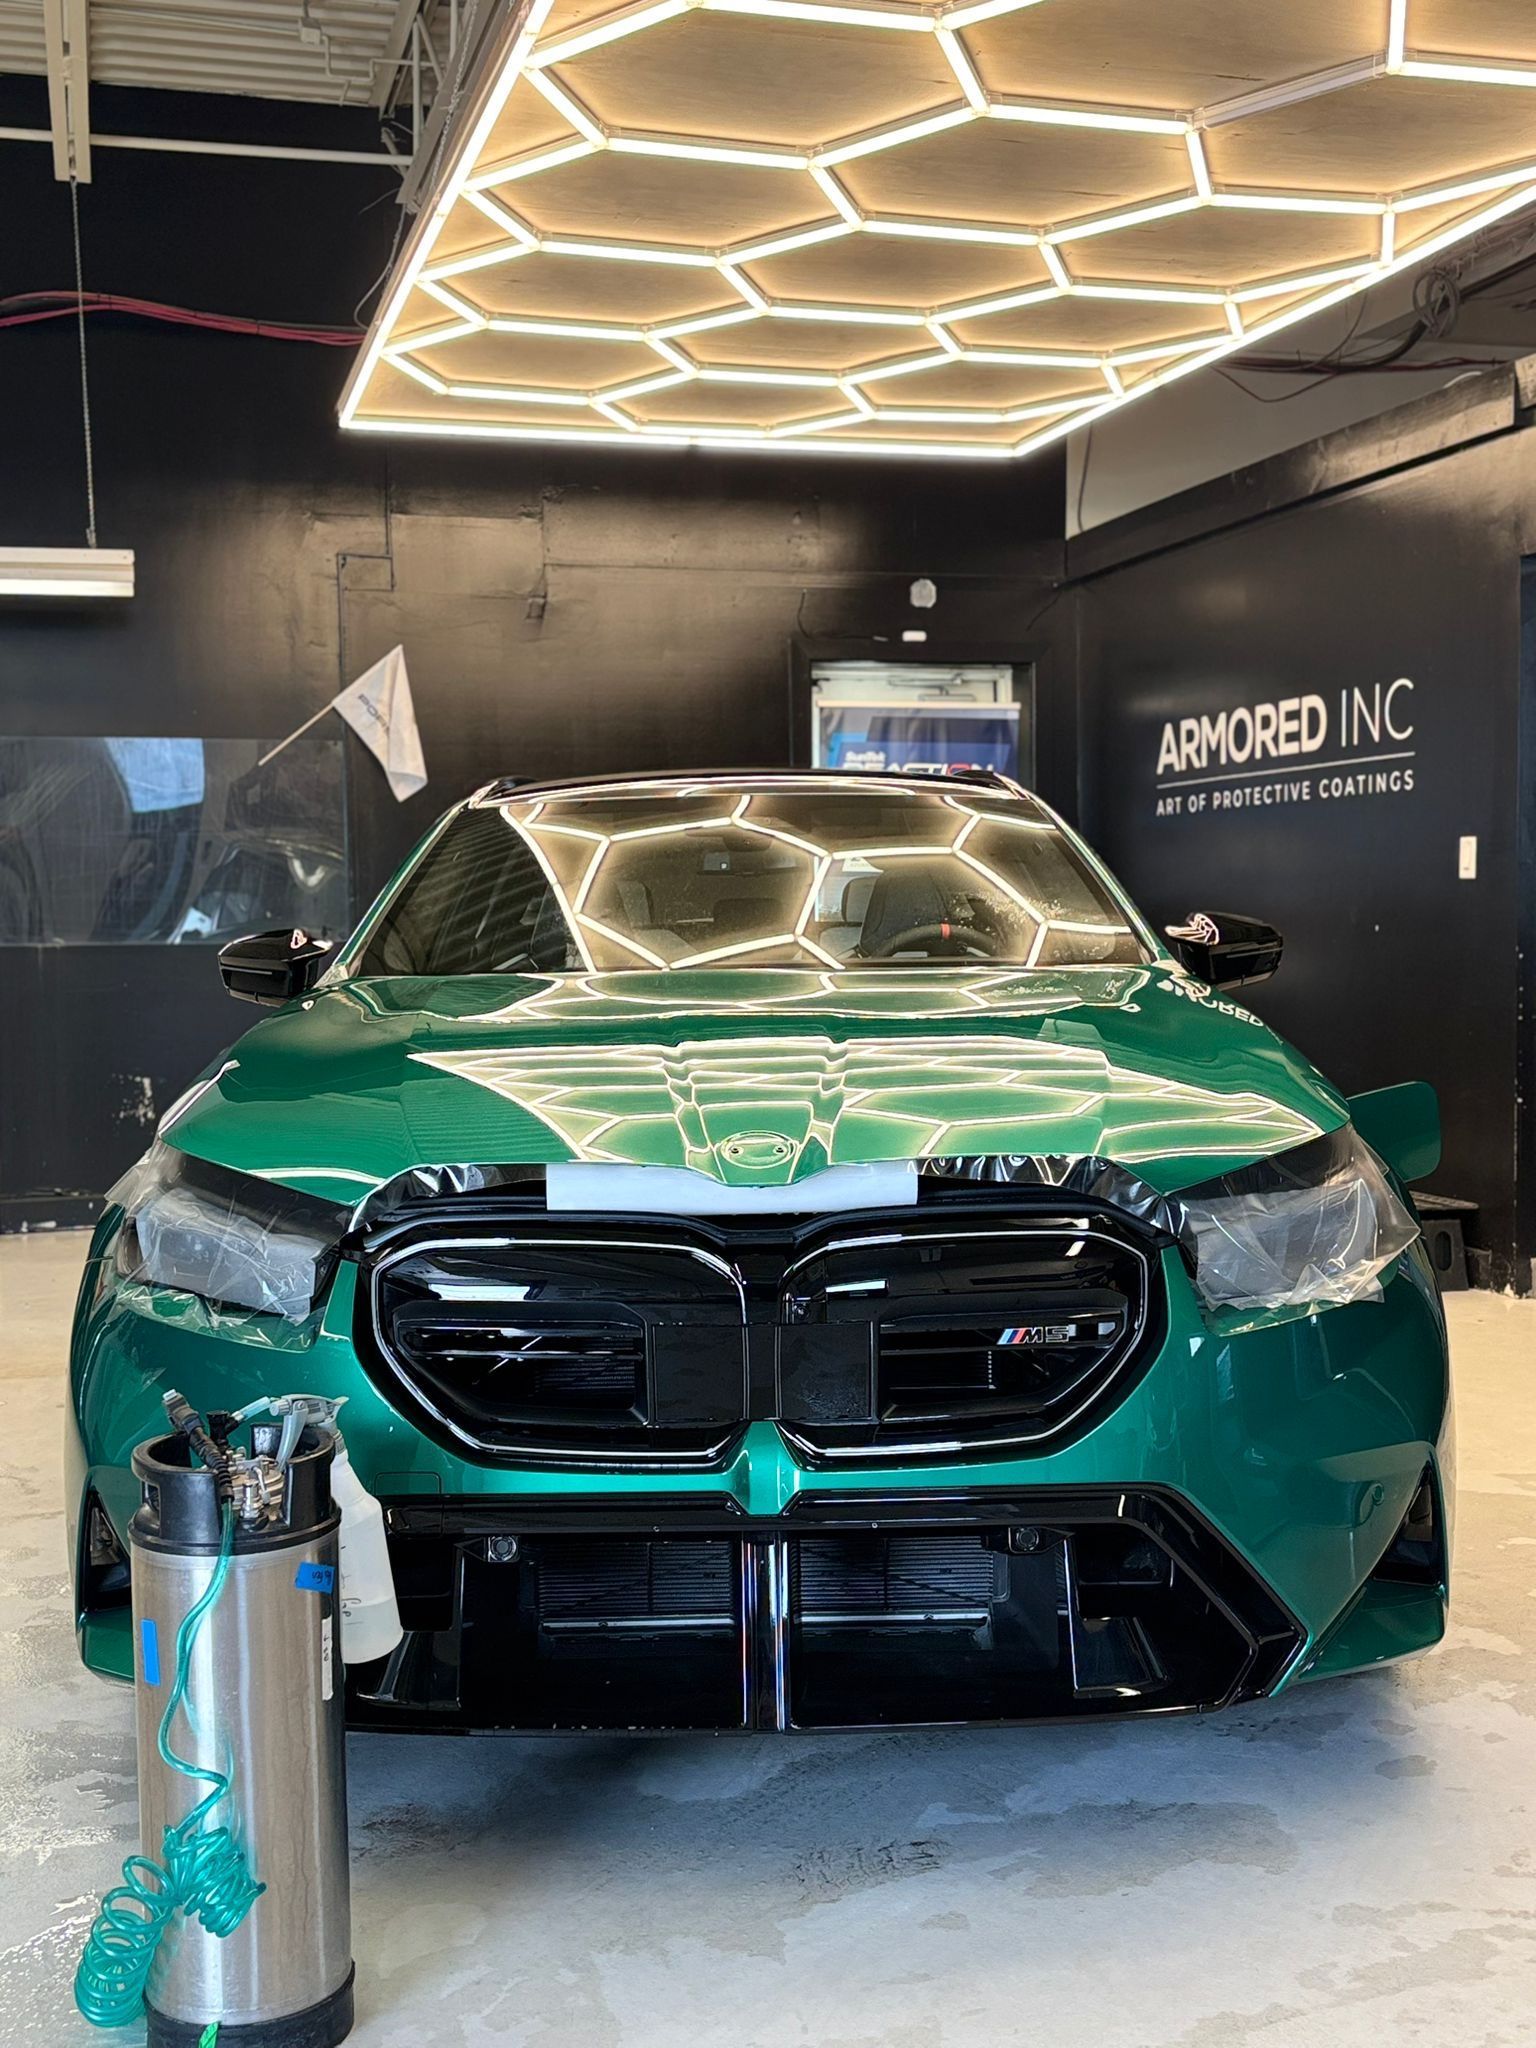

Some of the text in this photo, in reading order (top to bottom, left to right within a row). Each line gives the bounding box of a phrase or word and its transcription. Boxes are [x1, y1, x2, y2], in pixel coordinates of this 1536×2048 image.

[1156, 677, 1415, 774] ARMORED INC
[1156, 769, 1415, 817] ART OF PROTECTIVE COATINGS
[1018, 1326, 1070, 1344] M5
